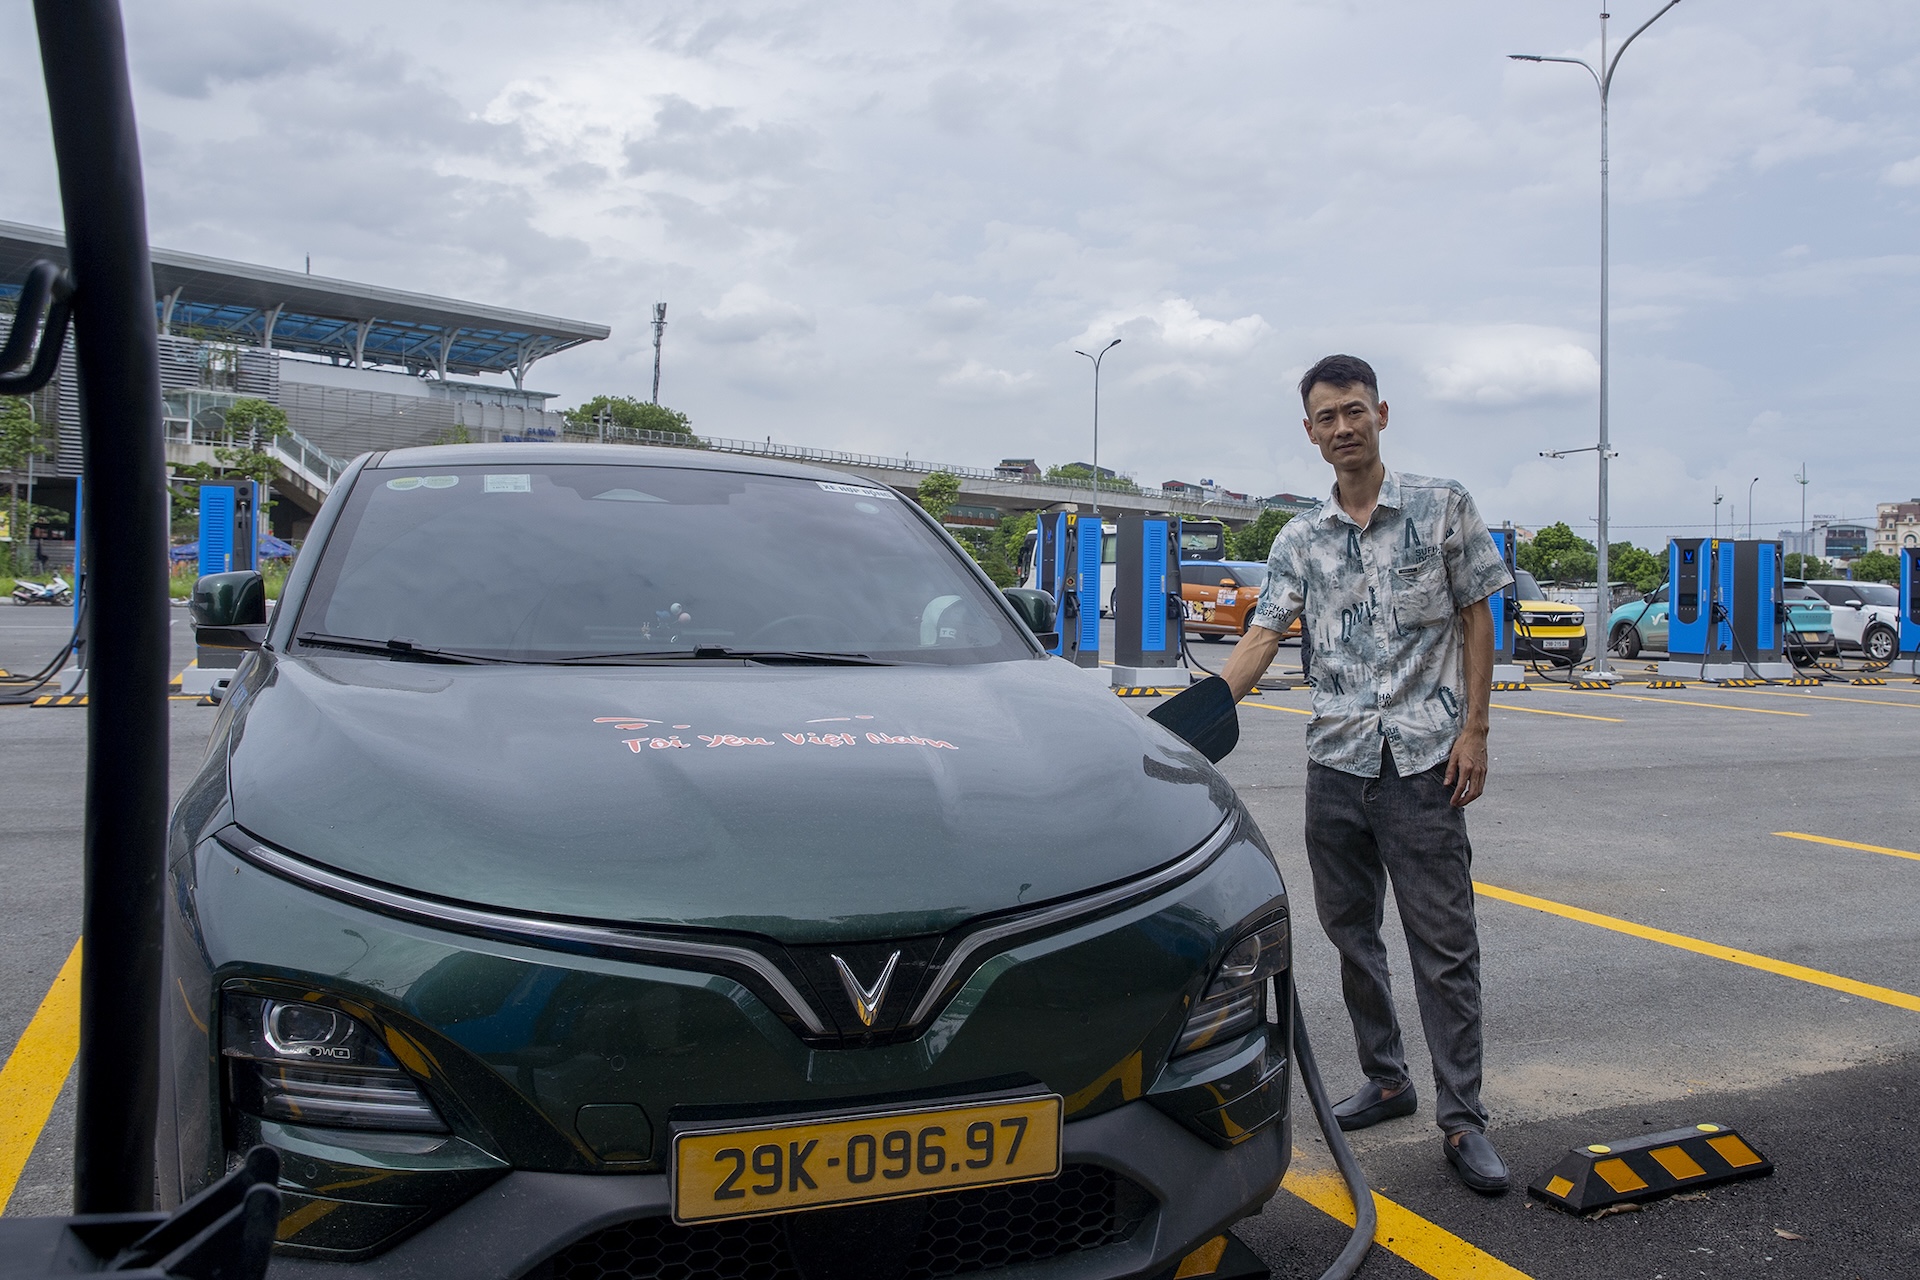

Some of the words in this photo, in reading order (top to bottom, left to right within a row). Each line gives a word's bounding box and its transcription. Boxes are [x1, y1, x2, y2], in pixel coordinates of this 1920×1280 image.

[1067, 514, 1077, 525] 17
[1712, 540, 1719, 549] 21
[713, 1115, 1029, 1201] 29K-096.97
